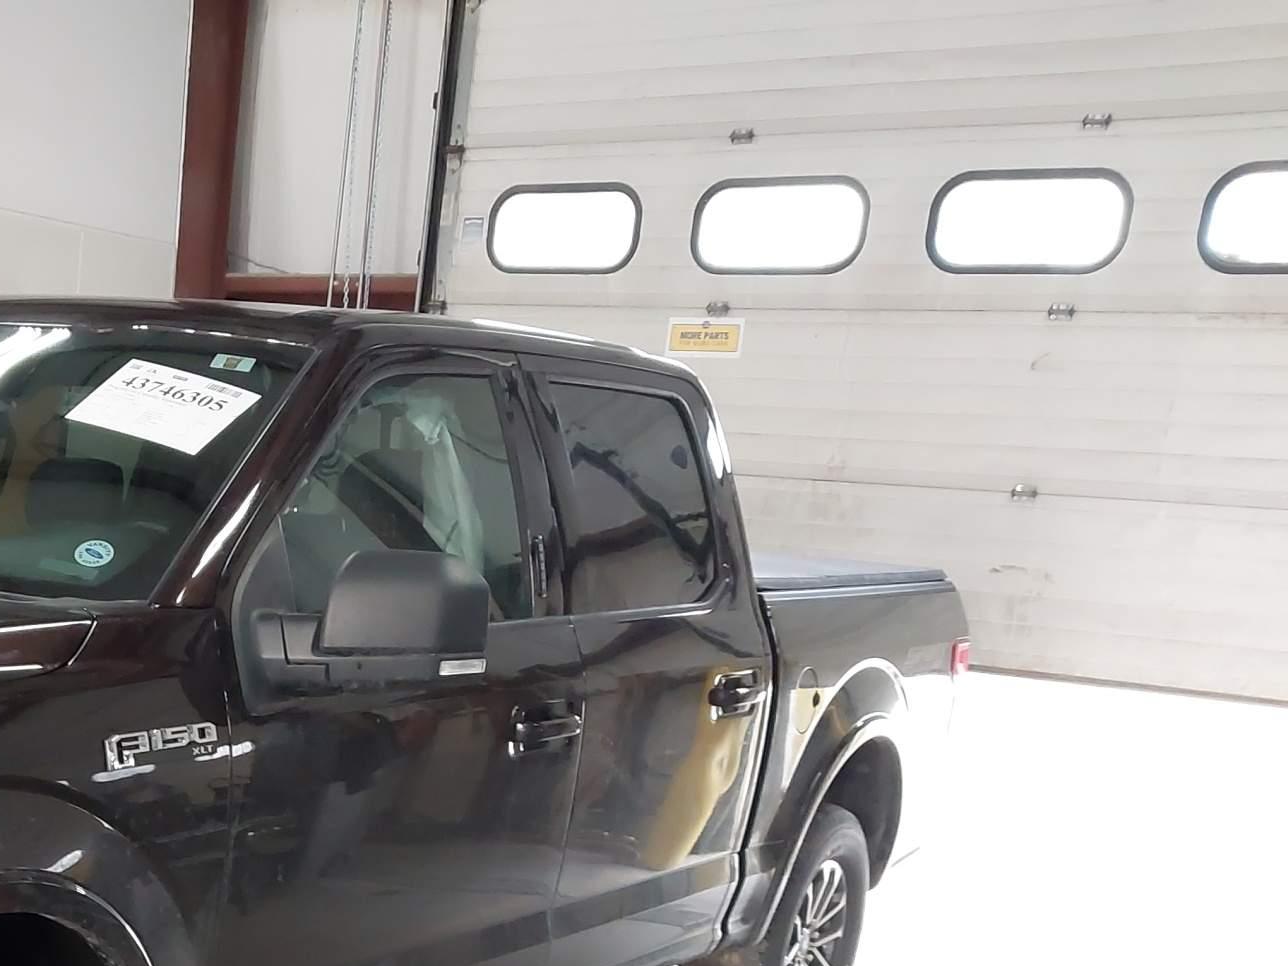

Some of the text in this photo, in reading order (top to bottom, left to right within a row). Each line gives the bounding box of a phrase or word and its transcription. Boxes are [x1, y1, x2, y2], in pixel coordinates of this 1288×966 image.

[679, 331, 729, 340] MORE PARTS
[122, 375, 230, 412] 43746305
[192, 745, 214, 756] XLT
